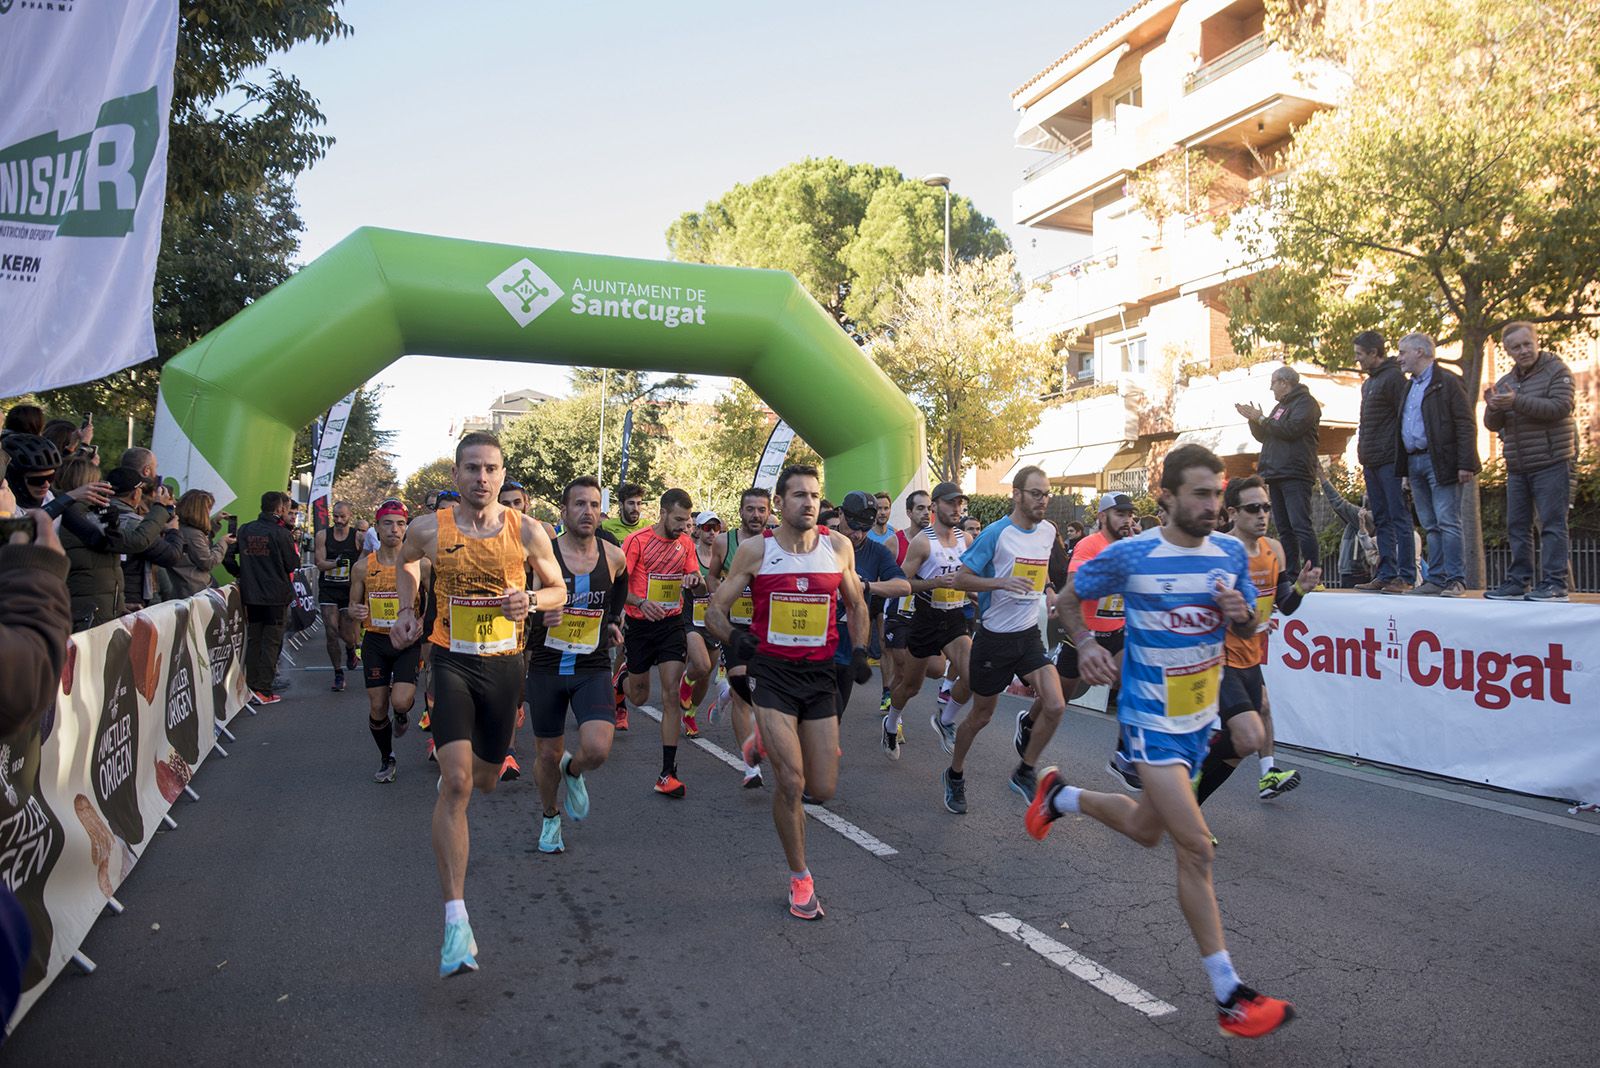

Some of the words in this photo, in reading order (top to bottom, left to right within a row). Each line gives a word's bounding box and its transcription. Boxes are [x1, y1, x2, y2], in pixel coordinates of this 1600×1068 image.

[1, 253, 42, 274] KERN
[572, 277, 682, 300] AJUNTAMENT
[686, 288, 707, 303] DE
[570, 293, 707, 328] SantCugat
[476, 614, 493, 622] ALEX
[477, 623, 493, 635] 416
[792, 618, 806, 629] 513
[1282, 618, 1382, 680] Sant
[1407, 629, 1573, 711] Cugat
[167, 688, 194, 730] ORIGEN
[98, 713, 132, 763] AMETLLER
[100, 740, 133, 801] ORIGEN
